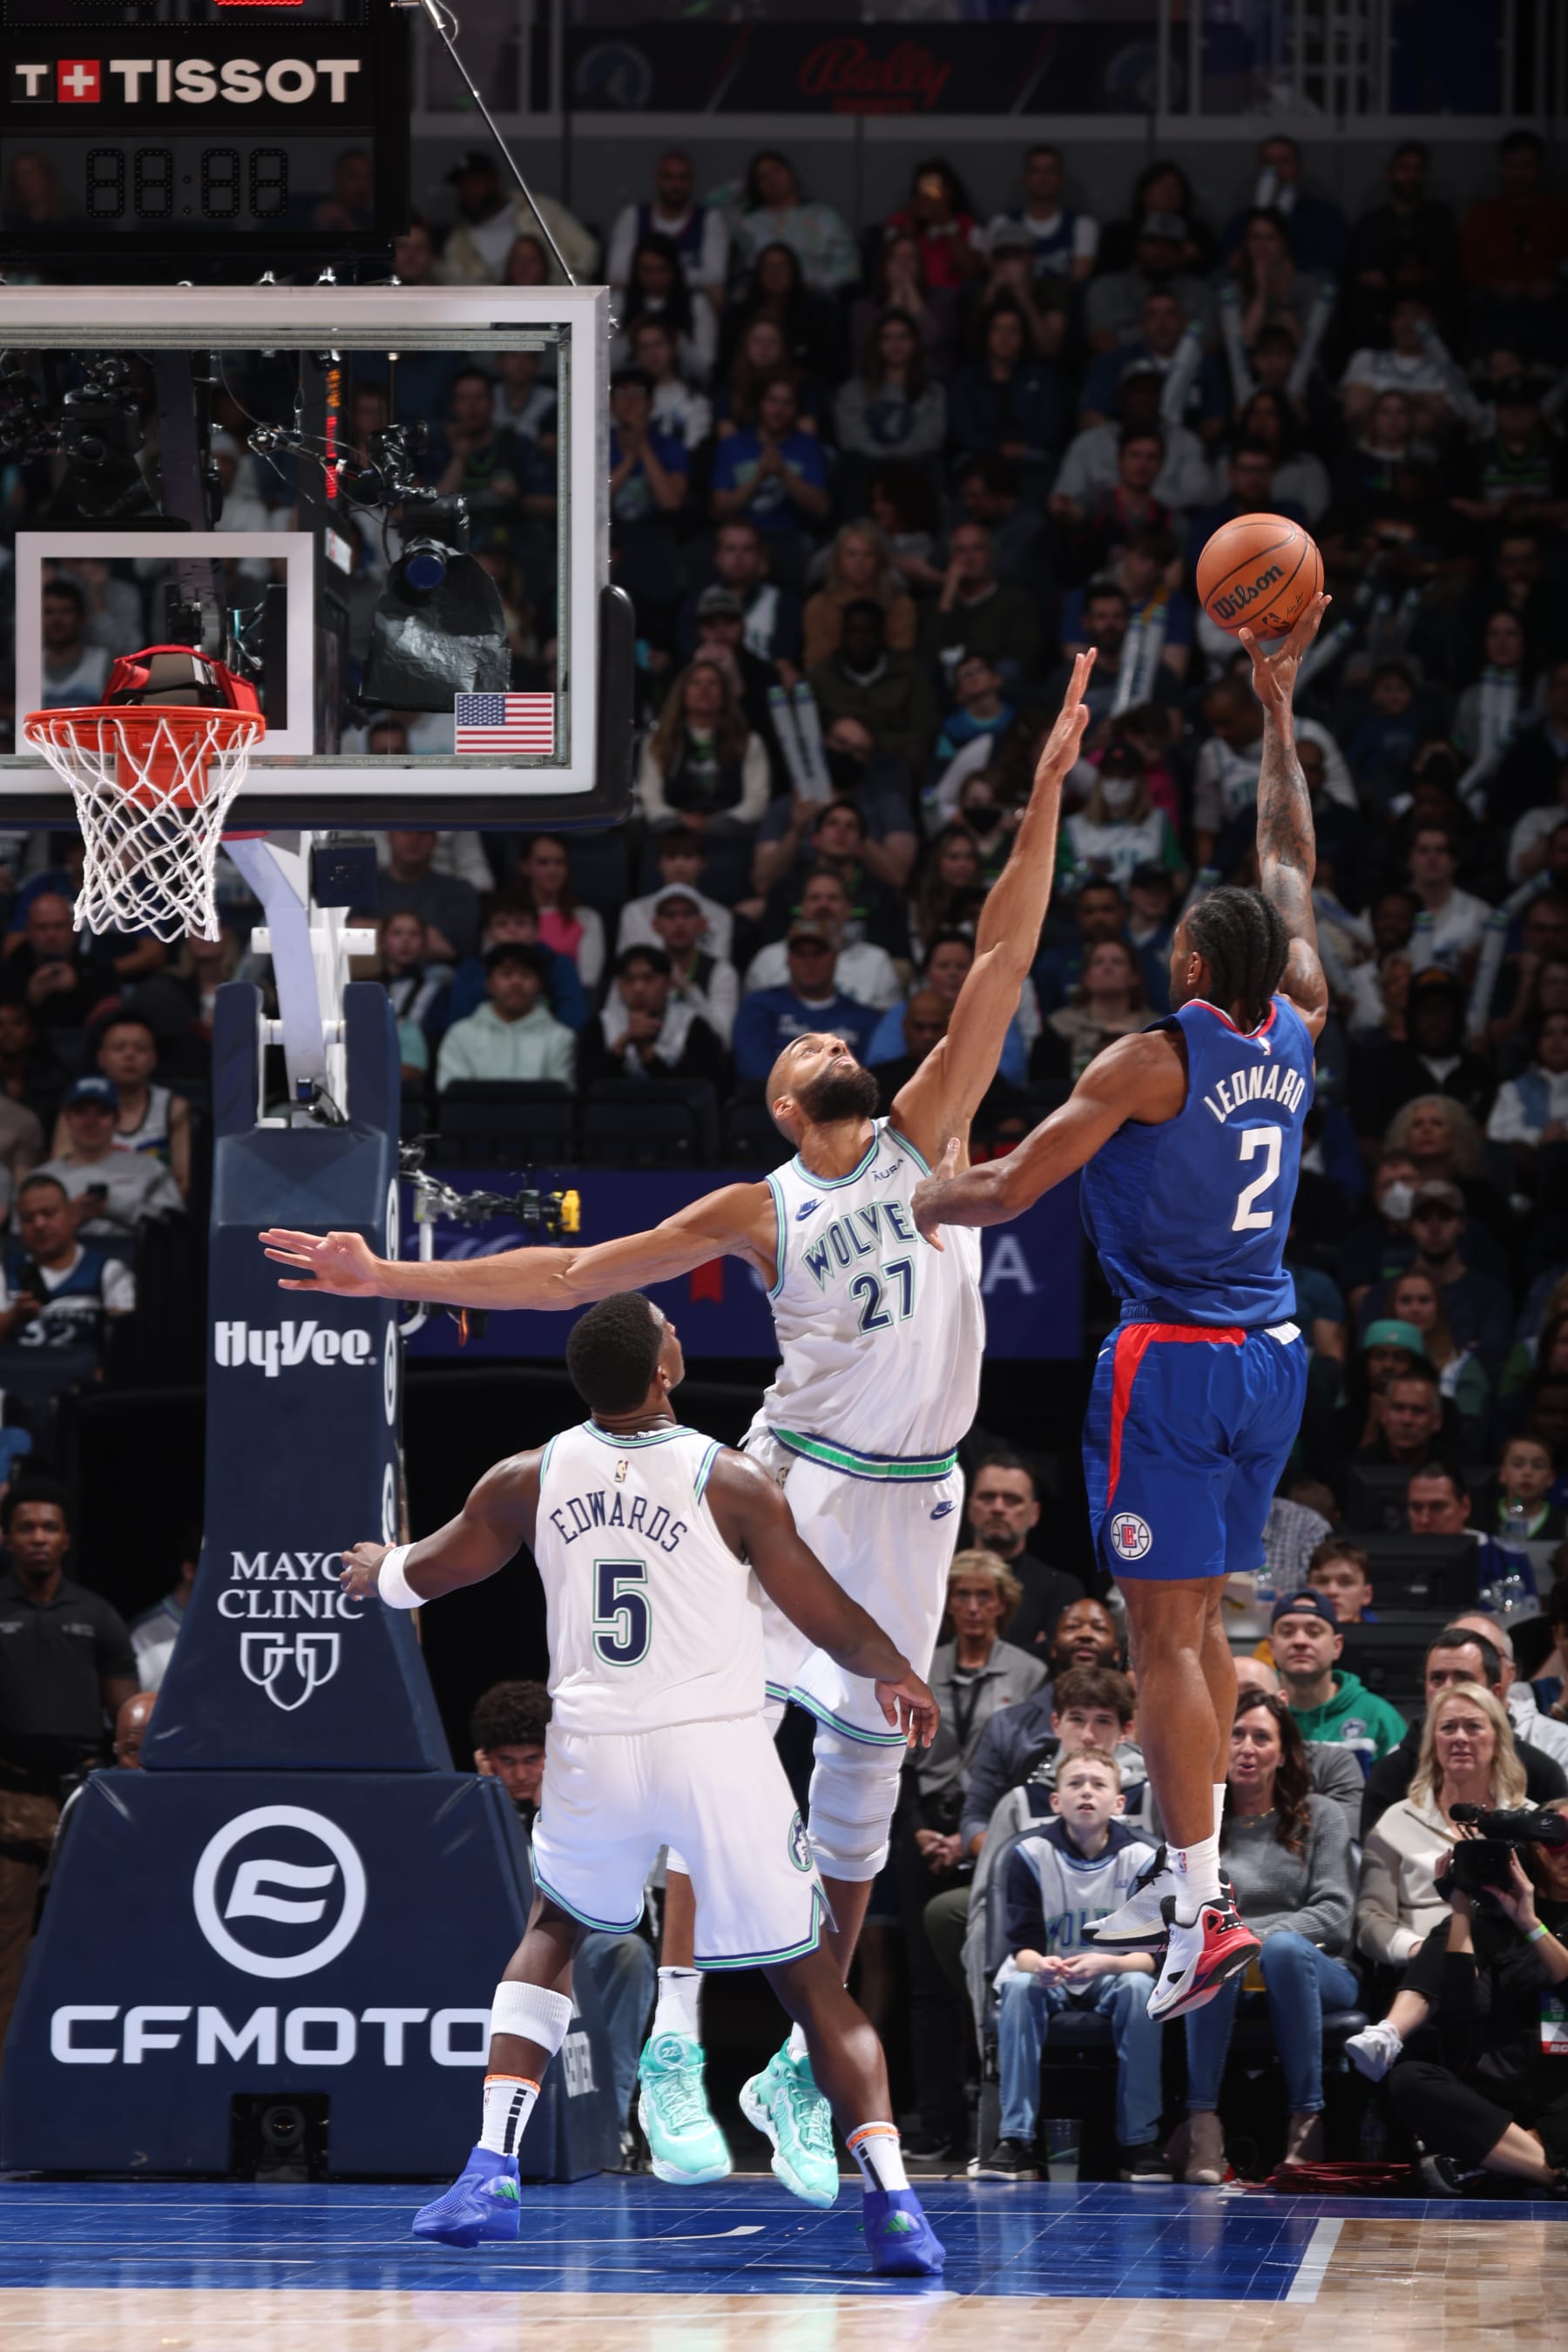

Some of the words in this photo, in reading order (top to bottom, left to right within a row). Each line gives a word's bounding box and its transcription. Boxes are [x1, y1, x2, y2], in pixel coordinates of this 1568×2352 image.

[110, 58, 360, 103] TISSOT
[1212, 564, 1284, 620] Wilson
[1204, 1064, 1306, 1123] LEONARD
[1232, 1125, 1282, 1231] 2
[801, 1200, 928, 1293] WOLVE
[849, 1255, 915, 1335] 27
[549, 1490, 687, 1552] EDWARDS
[217, 1589, 365, 1619] CLINIC
[592, 1558, 652, 1667] 5
[51, 2005, 491, 2065] CFMOTO
